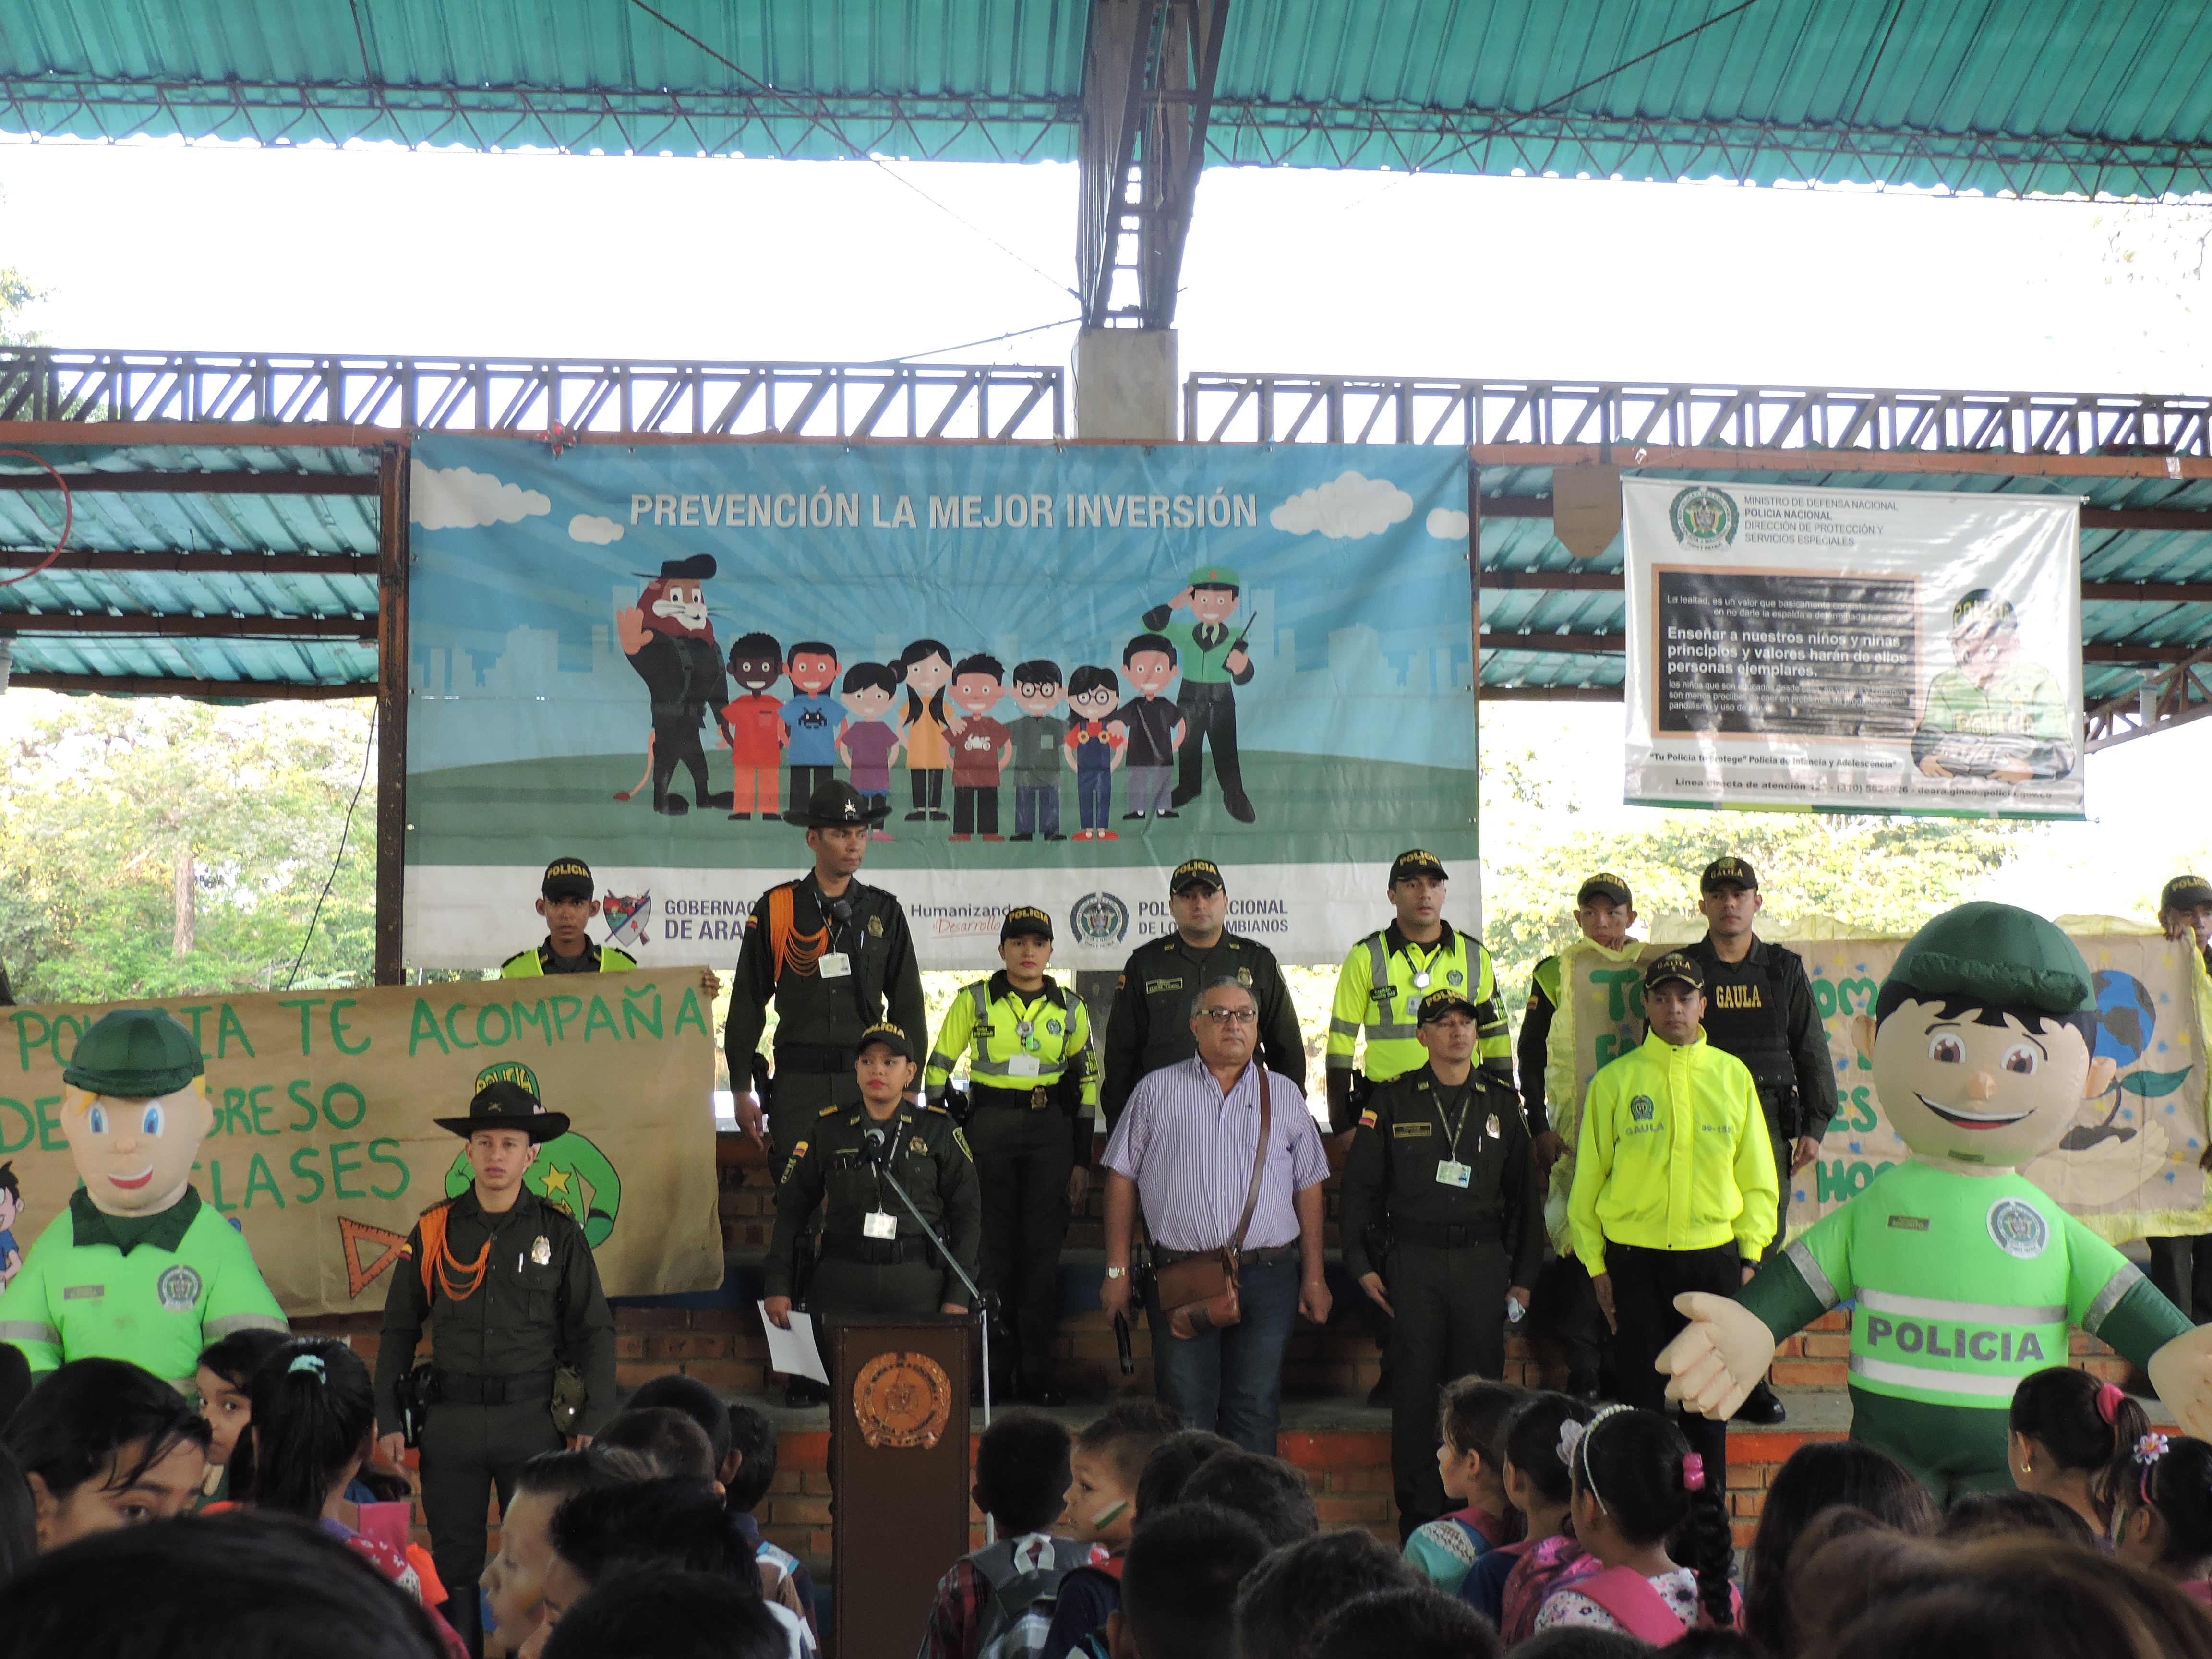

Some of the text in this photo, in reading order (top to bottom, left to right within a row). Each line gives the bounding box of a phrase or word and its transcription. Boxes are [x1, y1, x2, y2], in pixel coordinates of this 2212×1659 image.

[630, 485, 1257, 529] PREVENCIÓN LA MEJOR INVERSIÓN
[1744, 496, 1899, 511] MINISTRO DE DEFENSA NACIONAL
[1744, 508, 1832, 520] POLICIA NACIONAL
[1744, 520, 1884, 535] DIRECCIÓN DE PROTECCIÓN Y
[1745, 533, 1855, 546] SERVICIOS ESPECIALES
[1667, 595, 1678, 604] La
[1680, 595, 1710, 605] lealtad,
[1725, 598, 1735, 606] un
[1738, 598, 1757, 607] valor
[1760, 599, 1776, 608] que
[1727, 609, 1737, 617] no
[1739, 609, 1760, 618] darle
[1762, 609, 1770, 618] la
[1772, 610, 1804, 620] espalda
[1668, 626, 1900, 648] Enseñar a nuestros niños y niñas
[1668, 643, 1908, 664] principios y valores harán de ellos
[1668, 661, 1733, 675] personas
[1705, 682, 1719, 691] que
[1722, 682, 1736, 691] son
[1669, 691, 1683, 699] son
[1779, 757, 1790, 765] de
[1828, 759, 1834, 769] y
[1746, 780, 1758, 789] de
[547, 863, 589, 879] POLICIA
[1174, 861, 1217, 878] POLICIA
[1710, 868, 1743, 880] GAULA
[911, 903, 1012, 917] Humanizand
[1009, 908, 1049, 926] POLICIA
[665, 919, 693, 940] DE
[938, 914, 1001, 934] Desarrollo
[1139, 920, 1156, 935] DE
[1657, 960, 1691, 970] GAULA
[1715, 985, 1762, 1009] GAULA
[278, 998, 372, 1056] TE
[408, 984, 708, 1057] ACOMPAÑA
[1625, 1122, 1664, 1136] GAULA
[192, 1136, 410, 1212] LASES
[1867, 1315, 2044, 1362] POLICIA
